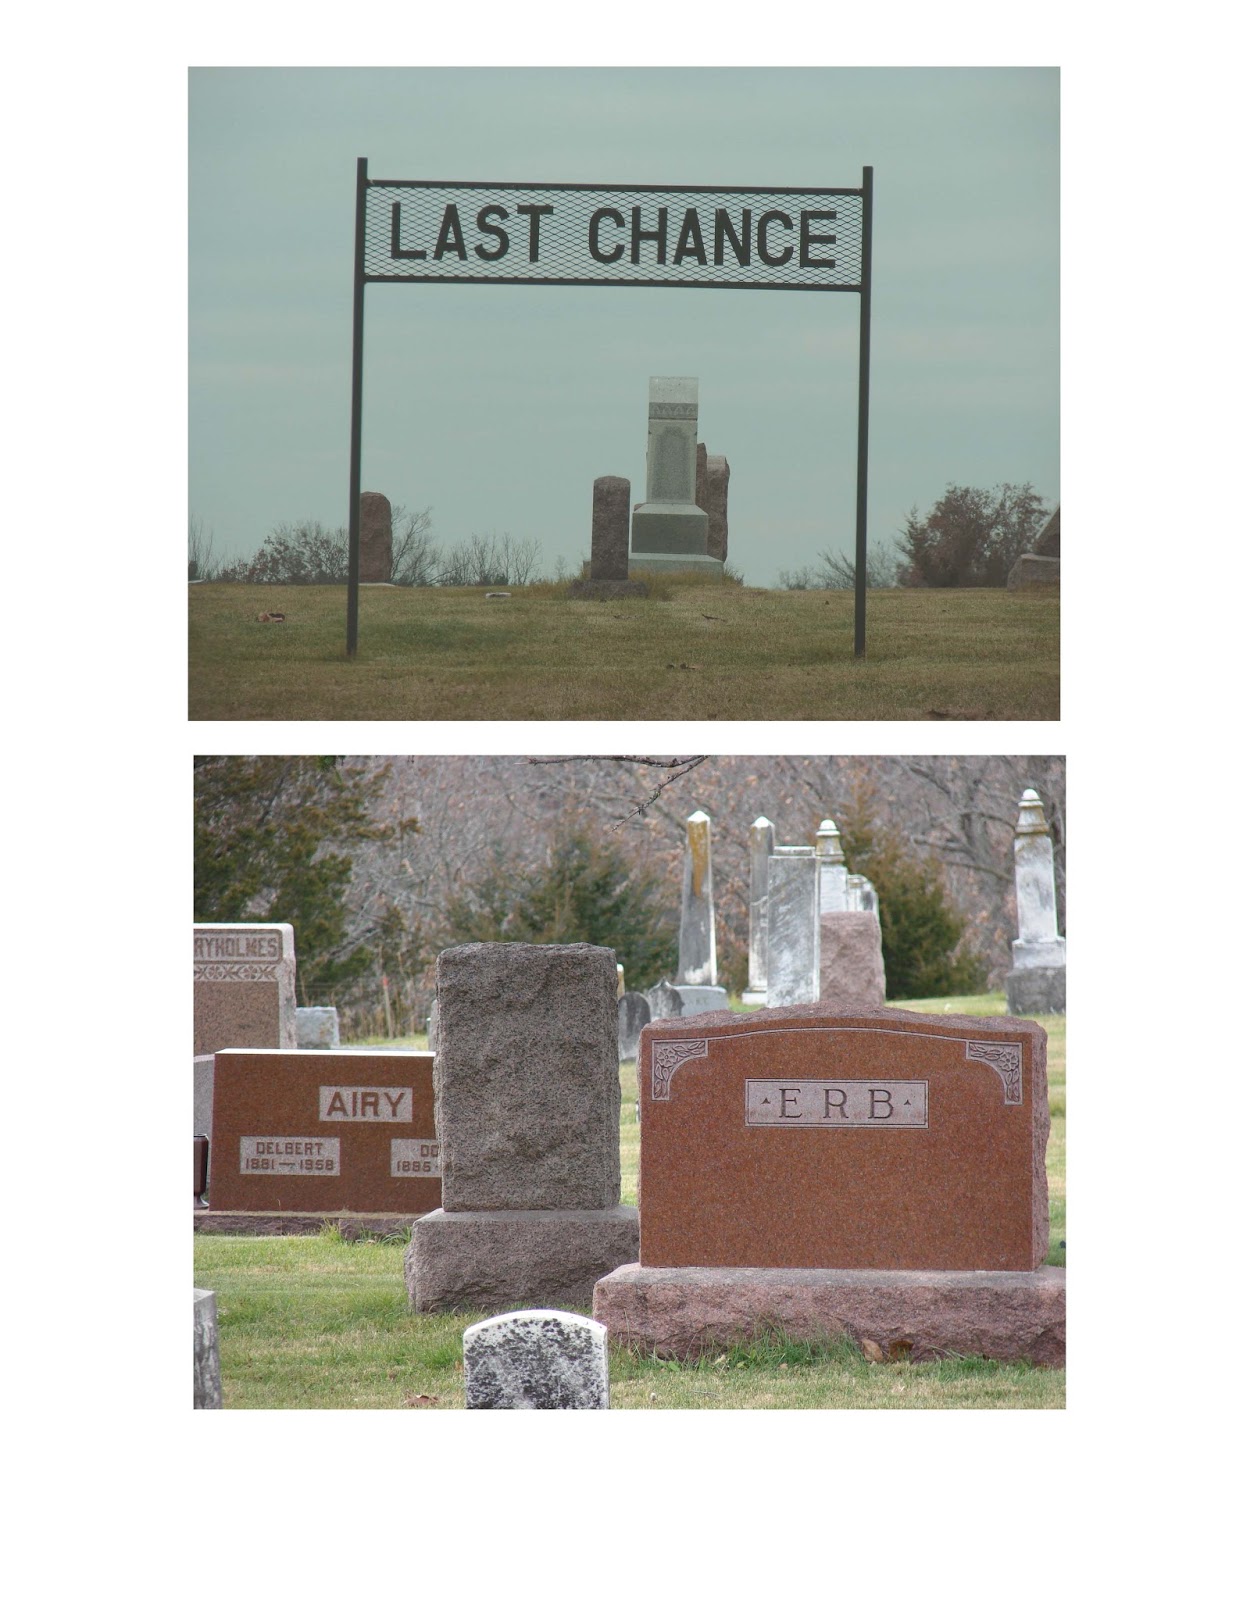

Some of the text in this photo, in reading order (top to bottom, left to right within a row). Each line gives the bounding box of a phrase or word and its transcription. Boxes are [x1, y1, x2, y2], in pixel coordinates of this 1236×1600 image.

[391, 202, 837, 268] LAST CHANCE
[326, 1092, 405, 1118] AIRY
[778, 1088, 894, 1119] ERB
[256, 1141, 323, 1155] DELBERT
